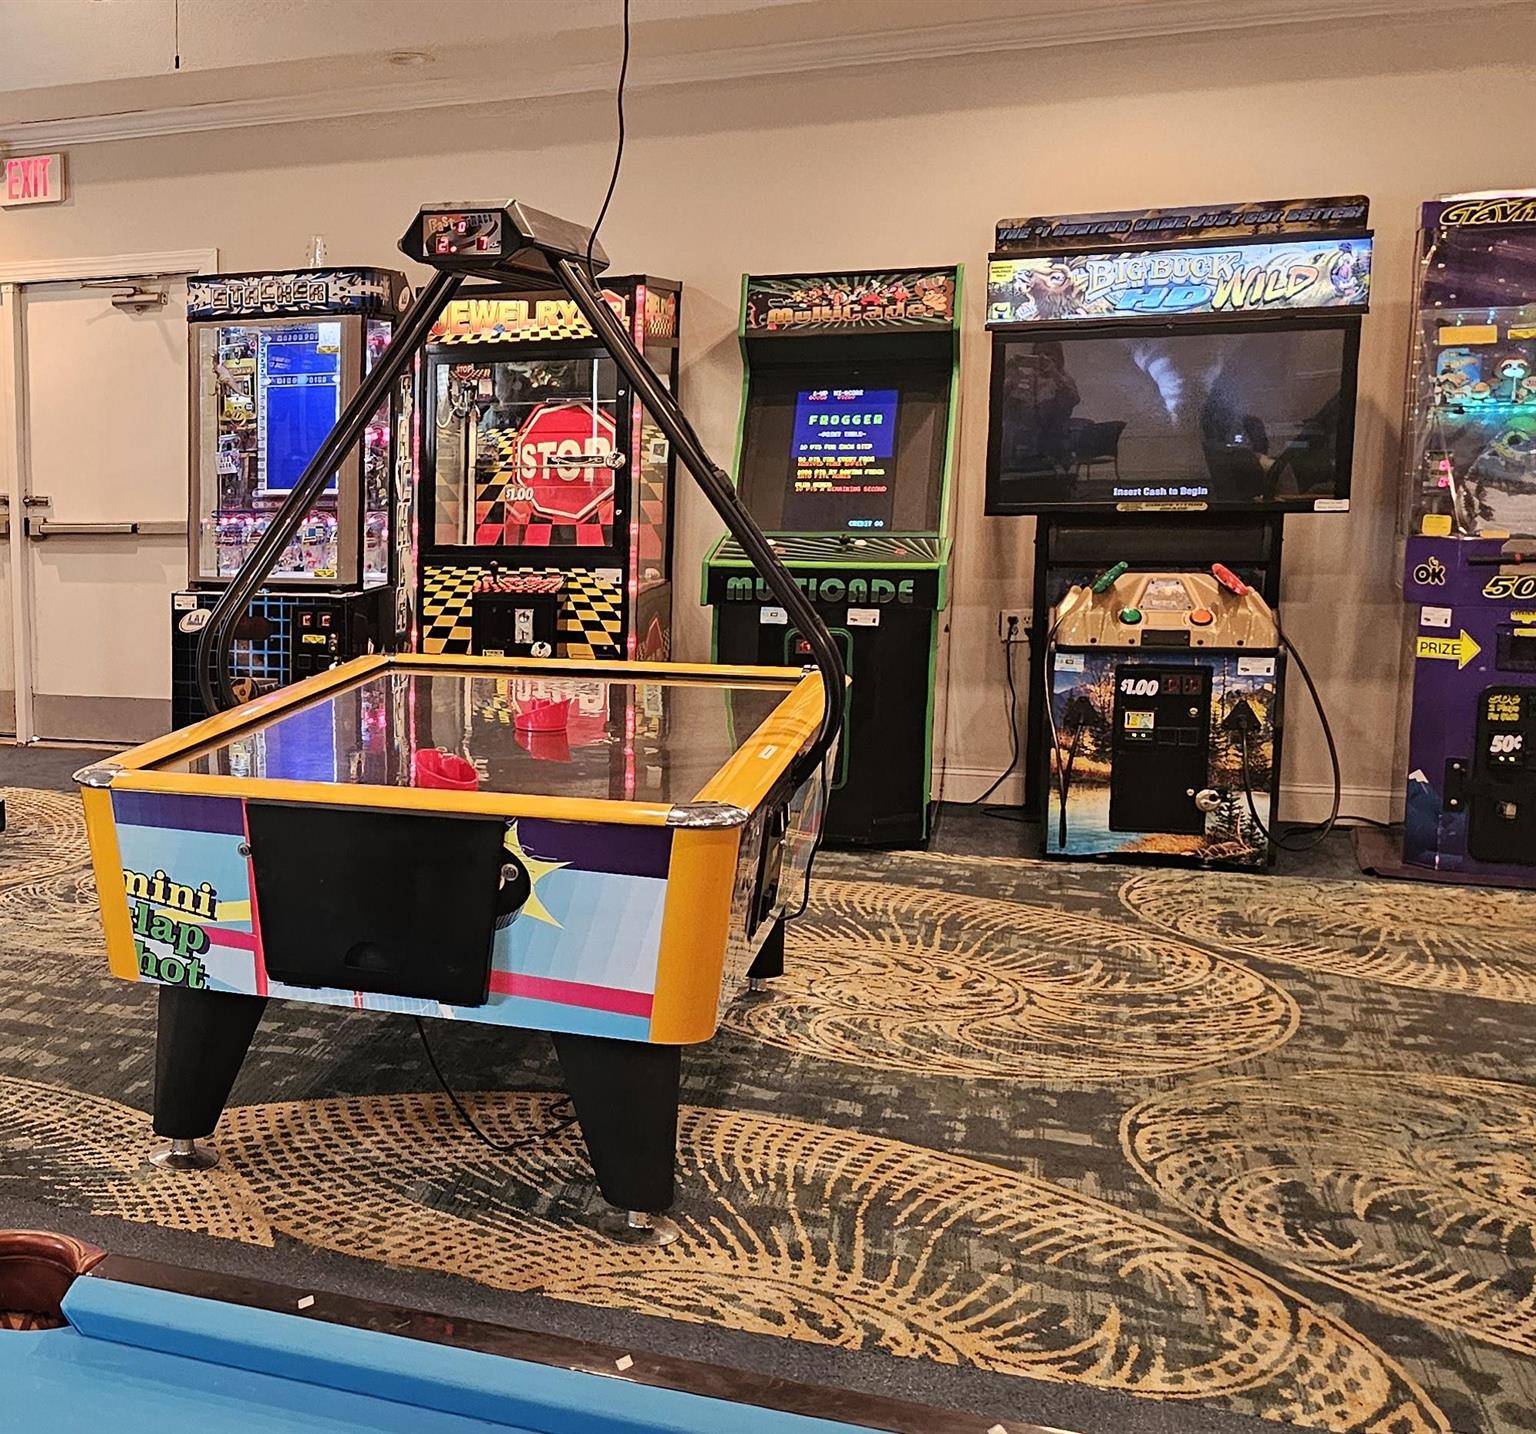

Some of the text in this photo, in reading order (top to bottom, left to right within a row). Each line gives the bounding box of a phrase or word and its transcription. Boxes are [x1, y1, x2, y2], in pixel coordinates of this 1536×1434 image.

[7, 158, 50, 199] EXIT
[1191, 211, 1242, 228] JUST
[1087, 252, 1242, 300] BIG BUCK
[1212, 264, 1319, 311] WILD
[212, 278, 326, 308] STACKER
[1114, 285, 1211, 309] HD
[432, 300, 582, 334] JEWELRY
[808, 414, 883, 425] FROGGER
[520, 437, 612, 483] STOP
[505, 487, 534, 501] $1.00
[1113, 486, 1208, 497] Insert Cash to Begin
[1414, 563, 1446, 586] OK
[726, 576, 914, 604] MUTICADE
[1420, 641, 1462, 656] PRIZE
[1120, 678, 1159, 697] $1.00
[1489, 734, 1523, 753] 50¢
[123, 868, 217, 921] mini
[129, 900, 211, 959] lap
[134, 938, 206, 990] hot
